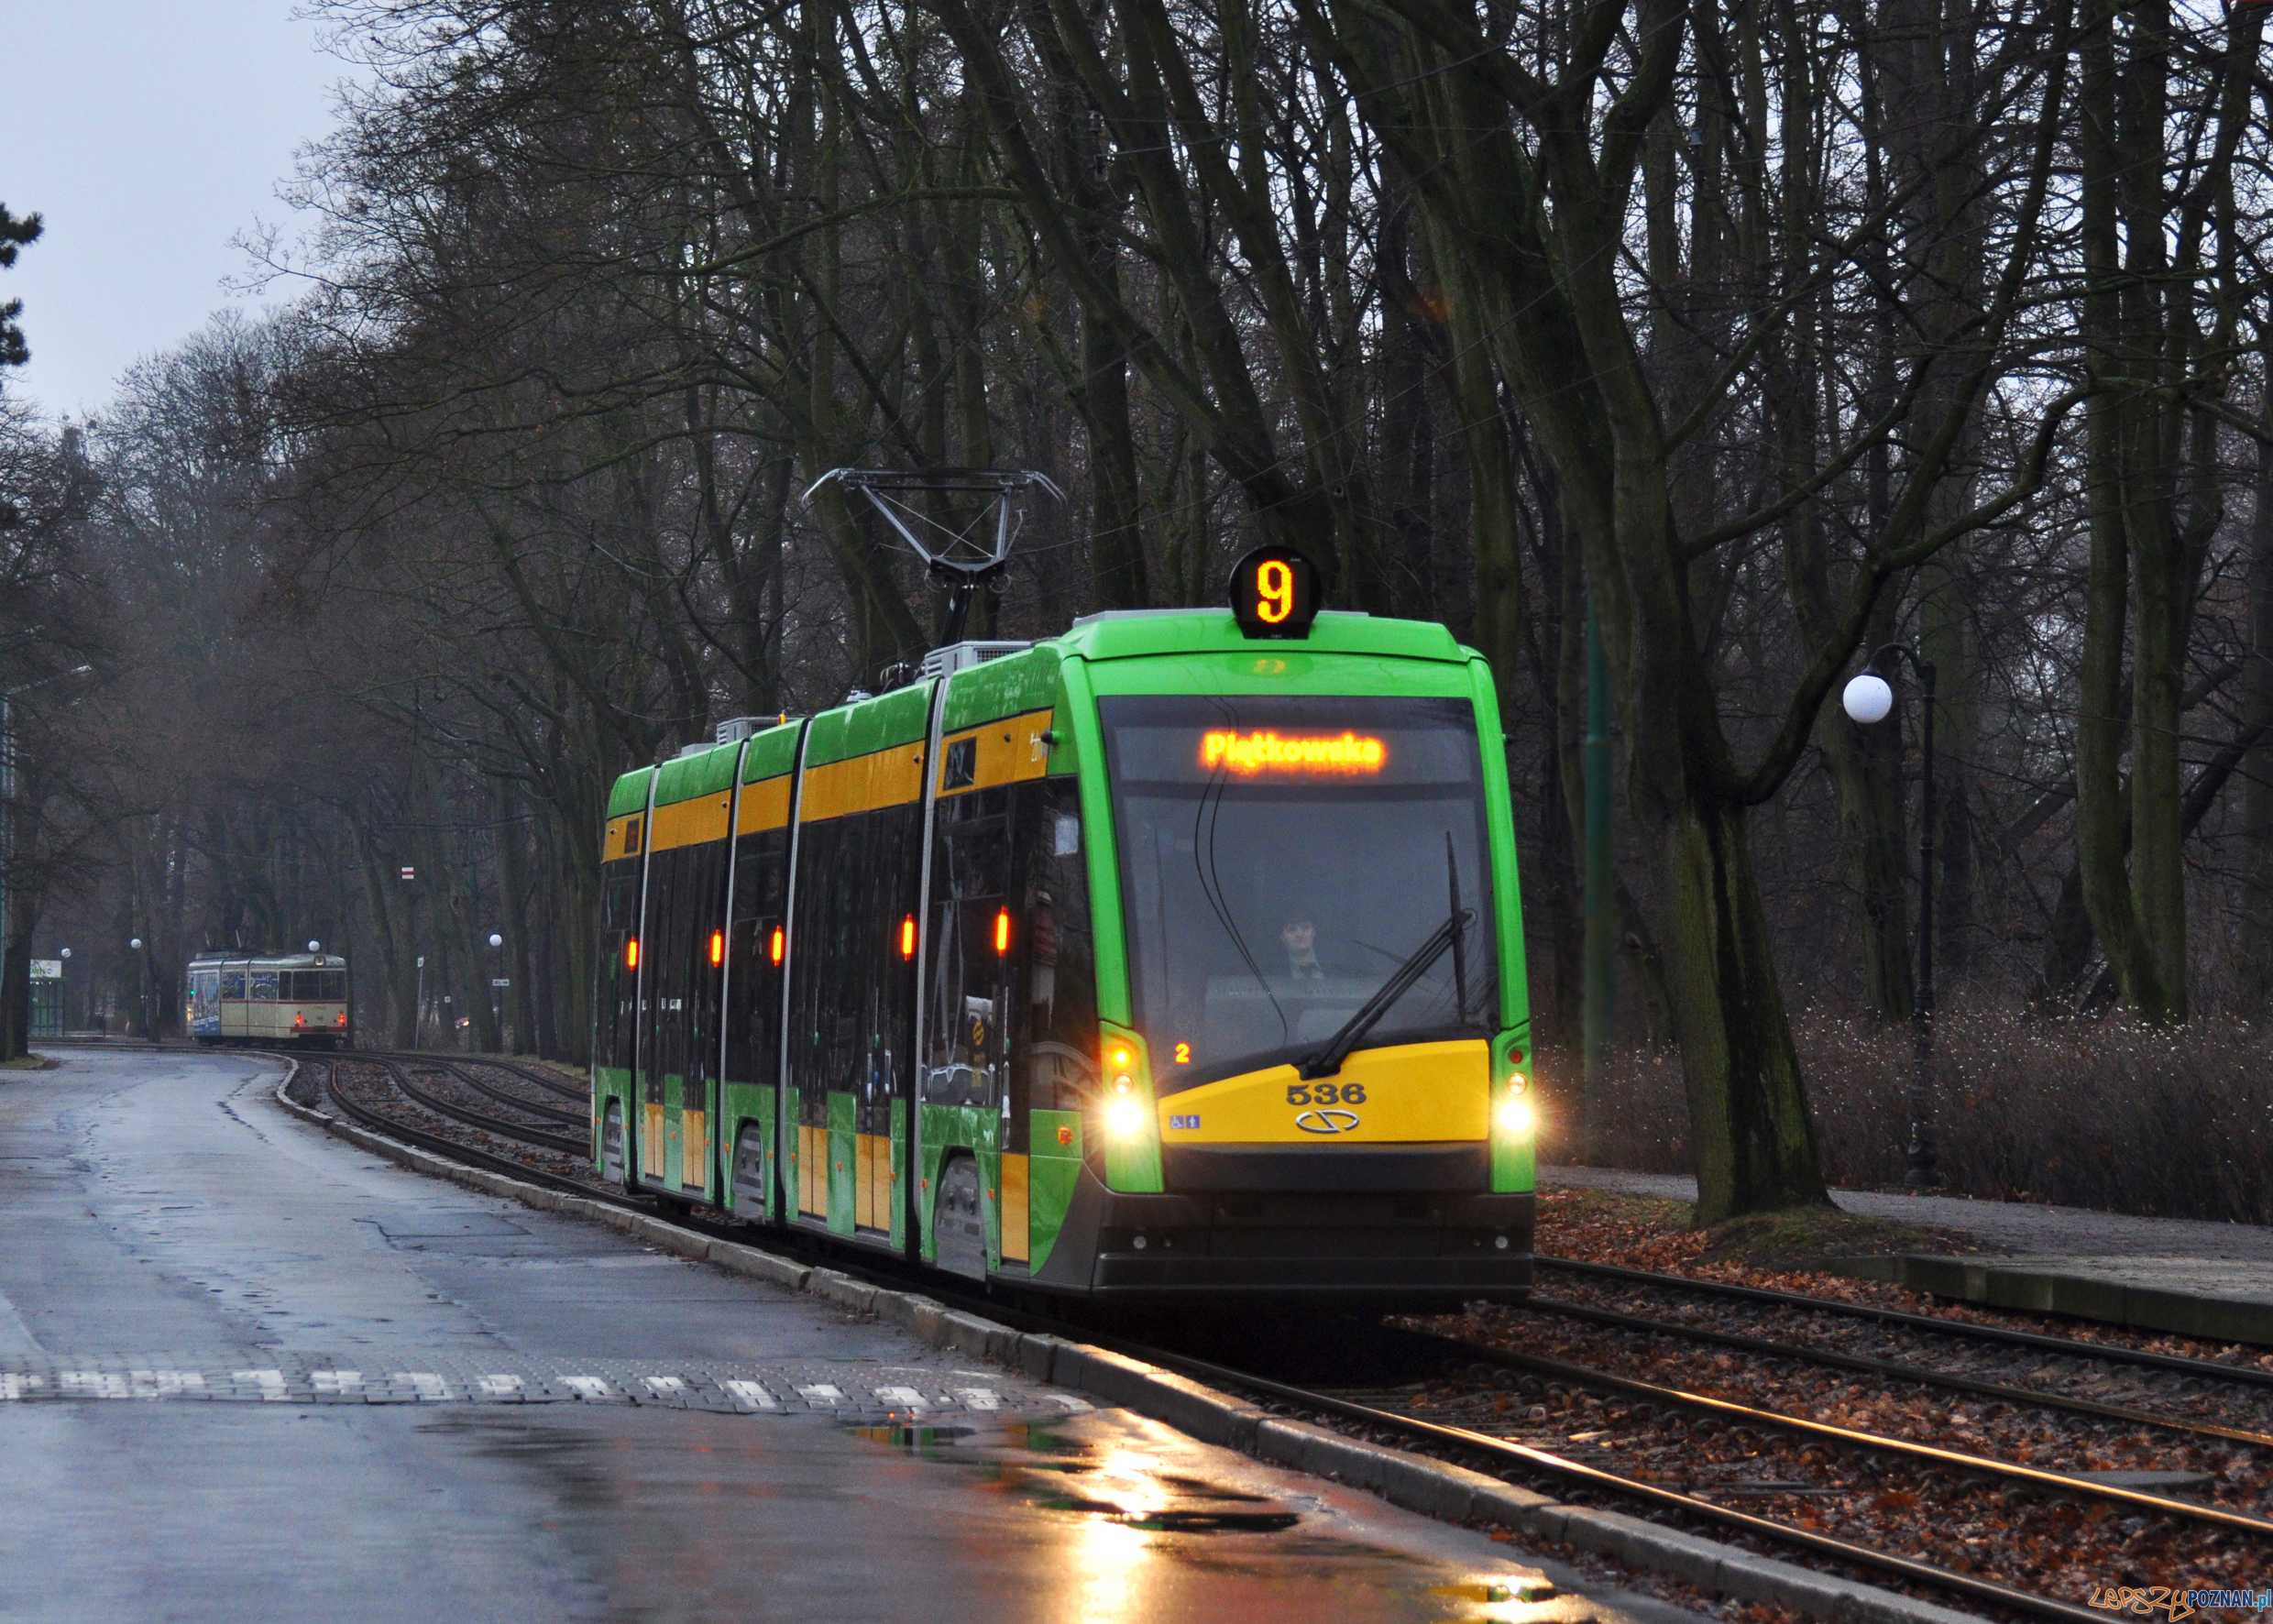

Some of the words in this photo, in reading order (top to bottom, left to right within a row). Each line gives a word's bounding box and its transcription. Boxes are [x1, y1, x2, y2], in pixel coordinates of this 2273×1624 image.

[1257, 559, 1292, 623] 9
[1175, 1043, 1190, 1063] 2
[1286, 1083, 1367, 1105] 536
